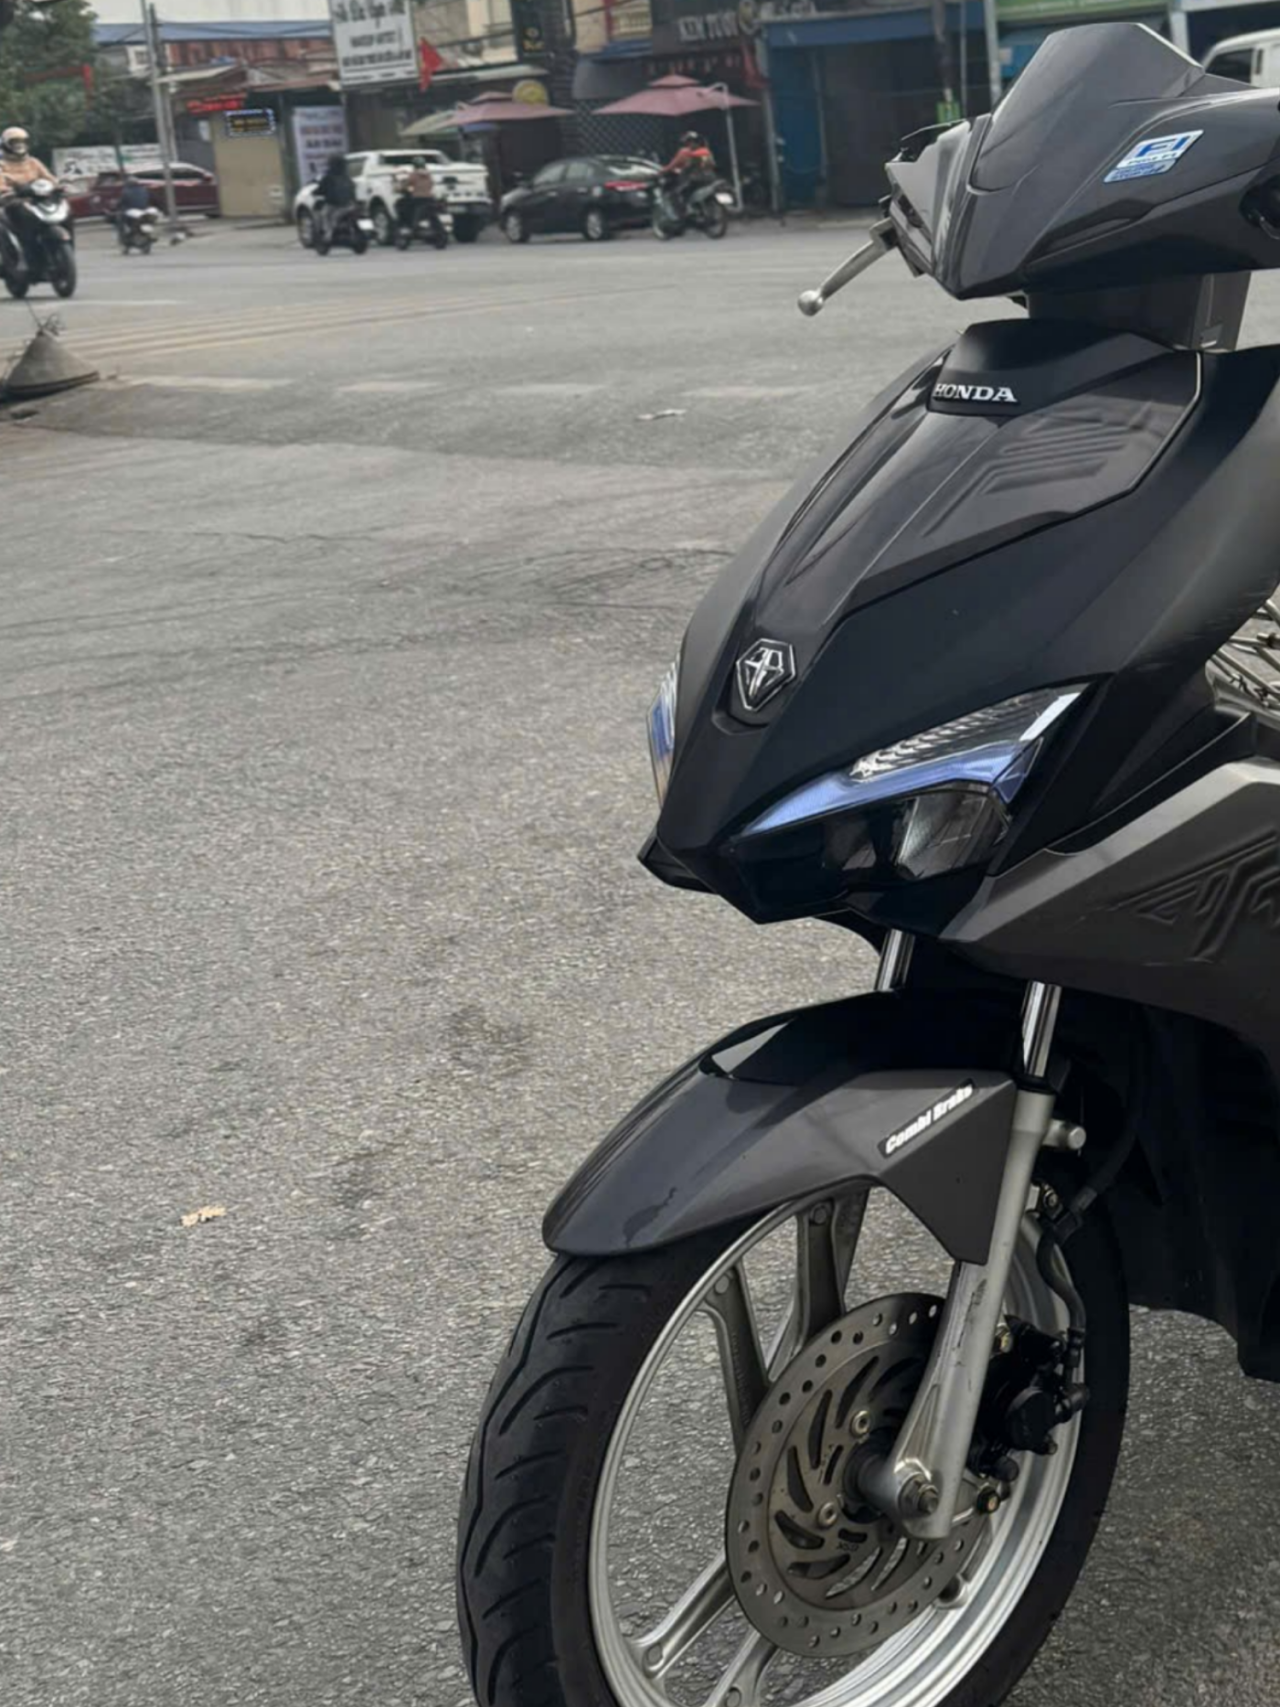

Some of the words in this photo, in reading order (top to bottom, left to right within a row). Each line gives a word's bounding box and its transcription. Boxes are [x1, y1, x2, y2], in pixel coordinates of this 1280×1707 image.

[1134, 135, 1191, 158] FI
[932, 383, 1018, 402] HONDA
[885, 1108, 932, 1154] Combi
[932, 1083, 973, 1121] Brake
